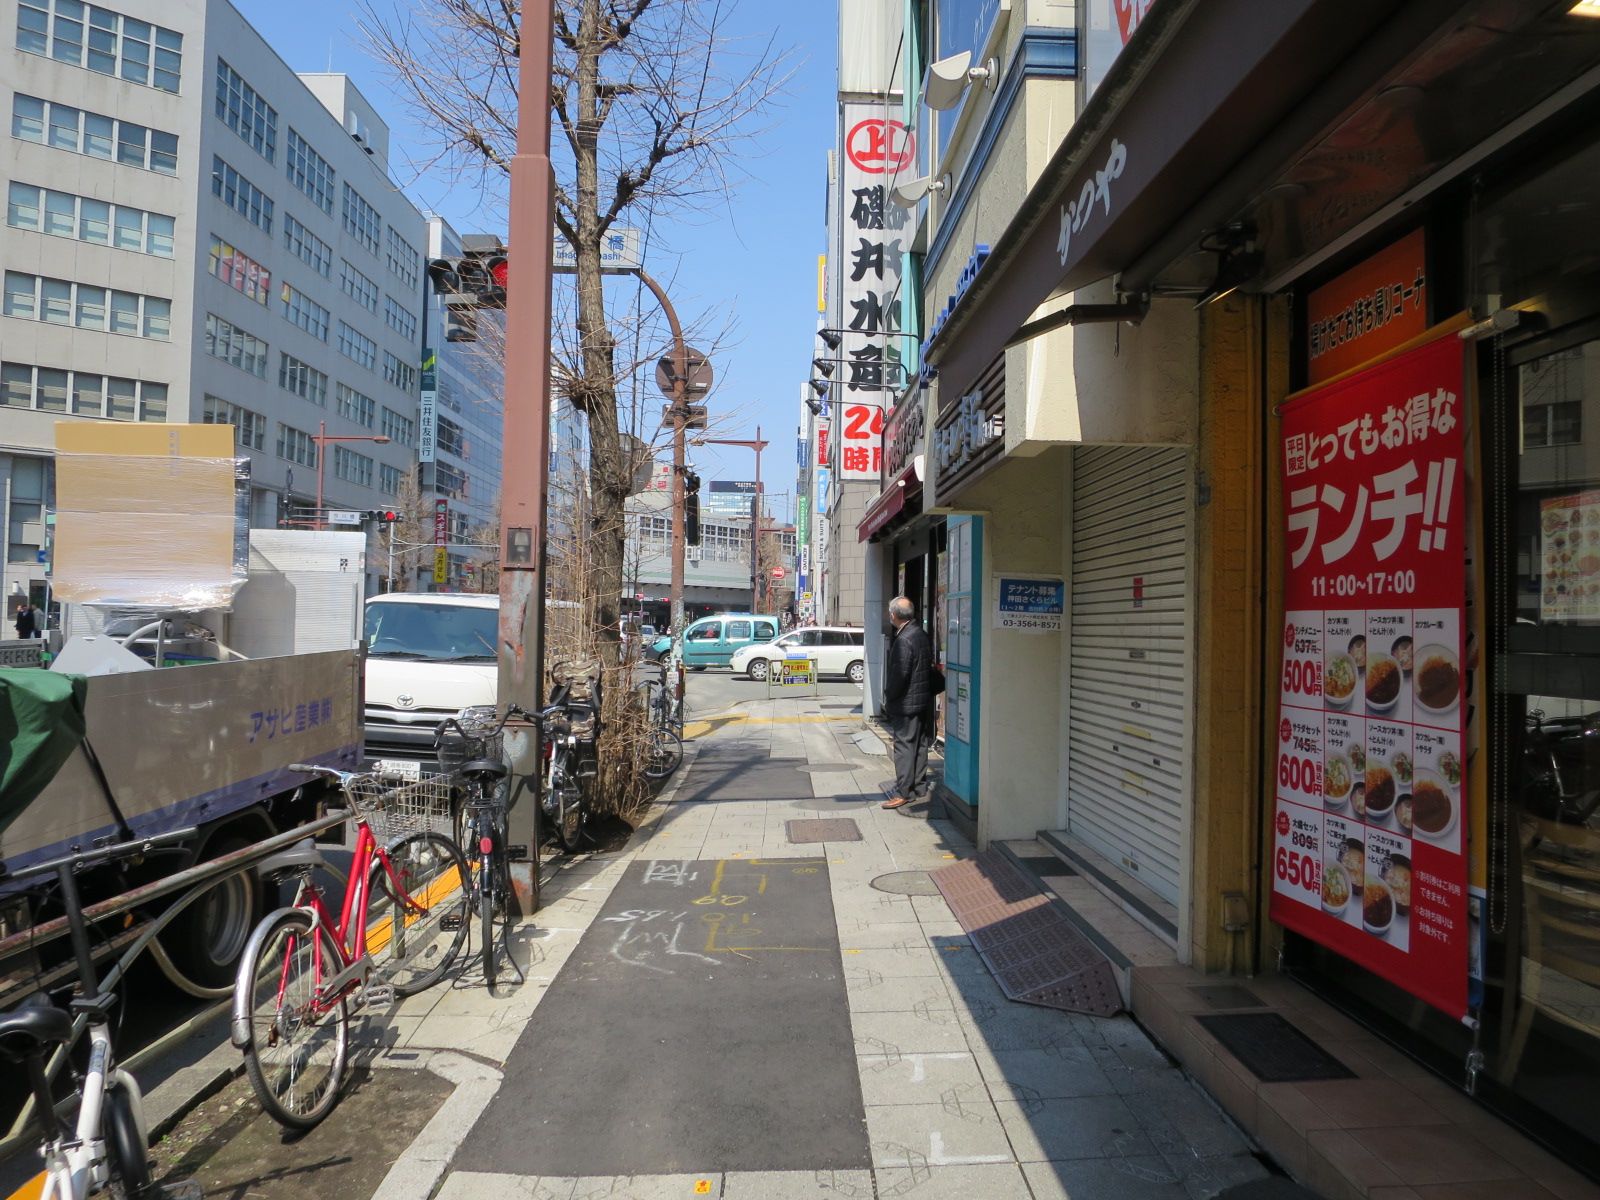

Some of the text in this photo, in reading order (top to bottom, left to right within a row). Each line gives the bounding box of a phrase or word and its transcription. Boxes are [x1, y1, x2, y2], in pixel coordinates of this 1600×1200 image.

[1057, 138, 1127, 266] かつや
[554, 234, 624, 250] 今橋
[422, 396, 432, 457] 三井住友銀行
[1287, 438, 1304, 452] 平日
[1307, 387, 1457, 470] とってもお得な
[1288, 454, 1305, 471] 限定
[1288, 457, 1457, 570] ランチ!!
[1292, 723, 1321, 736] サラダセット
